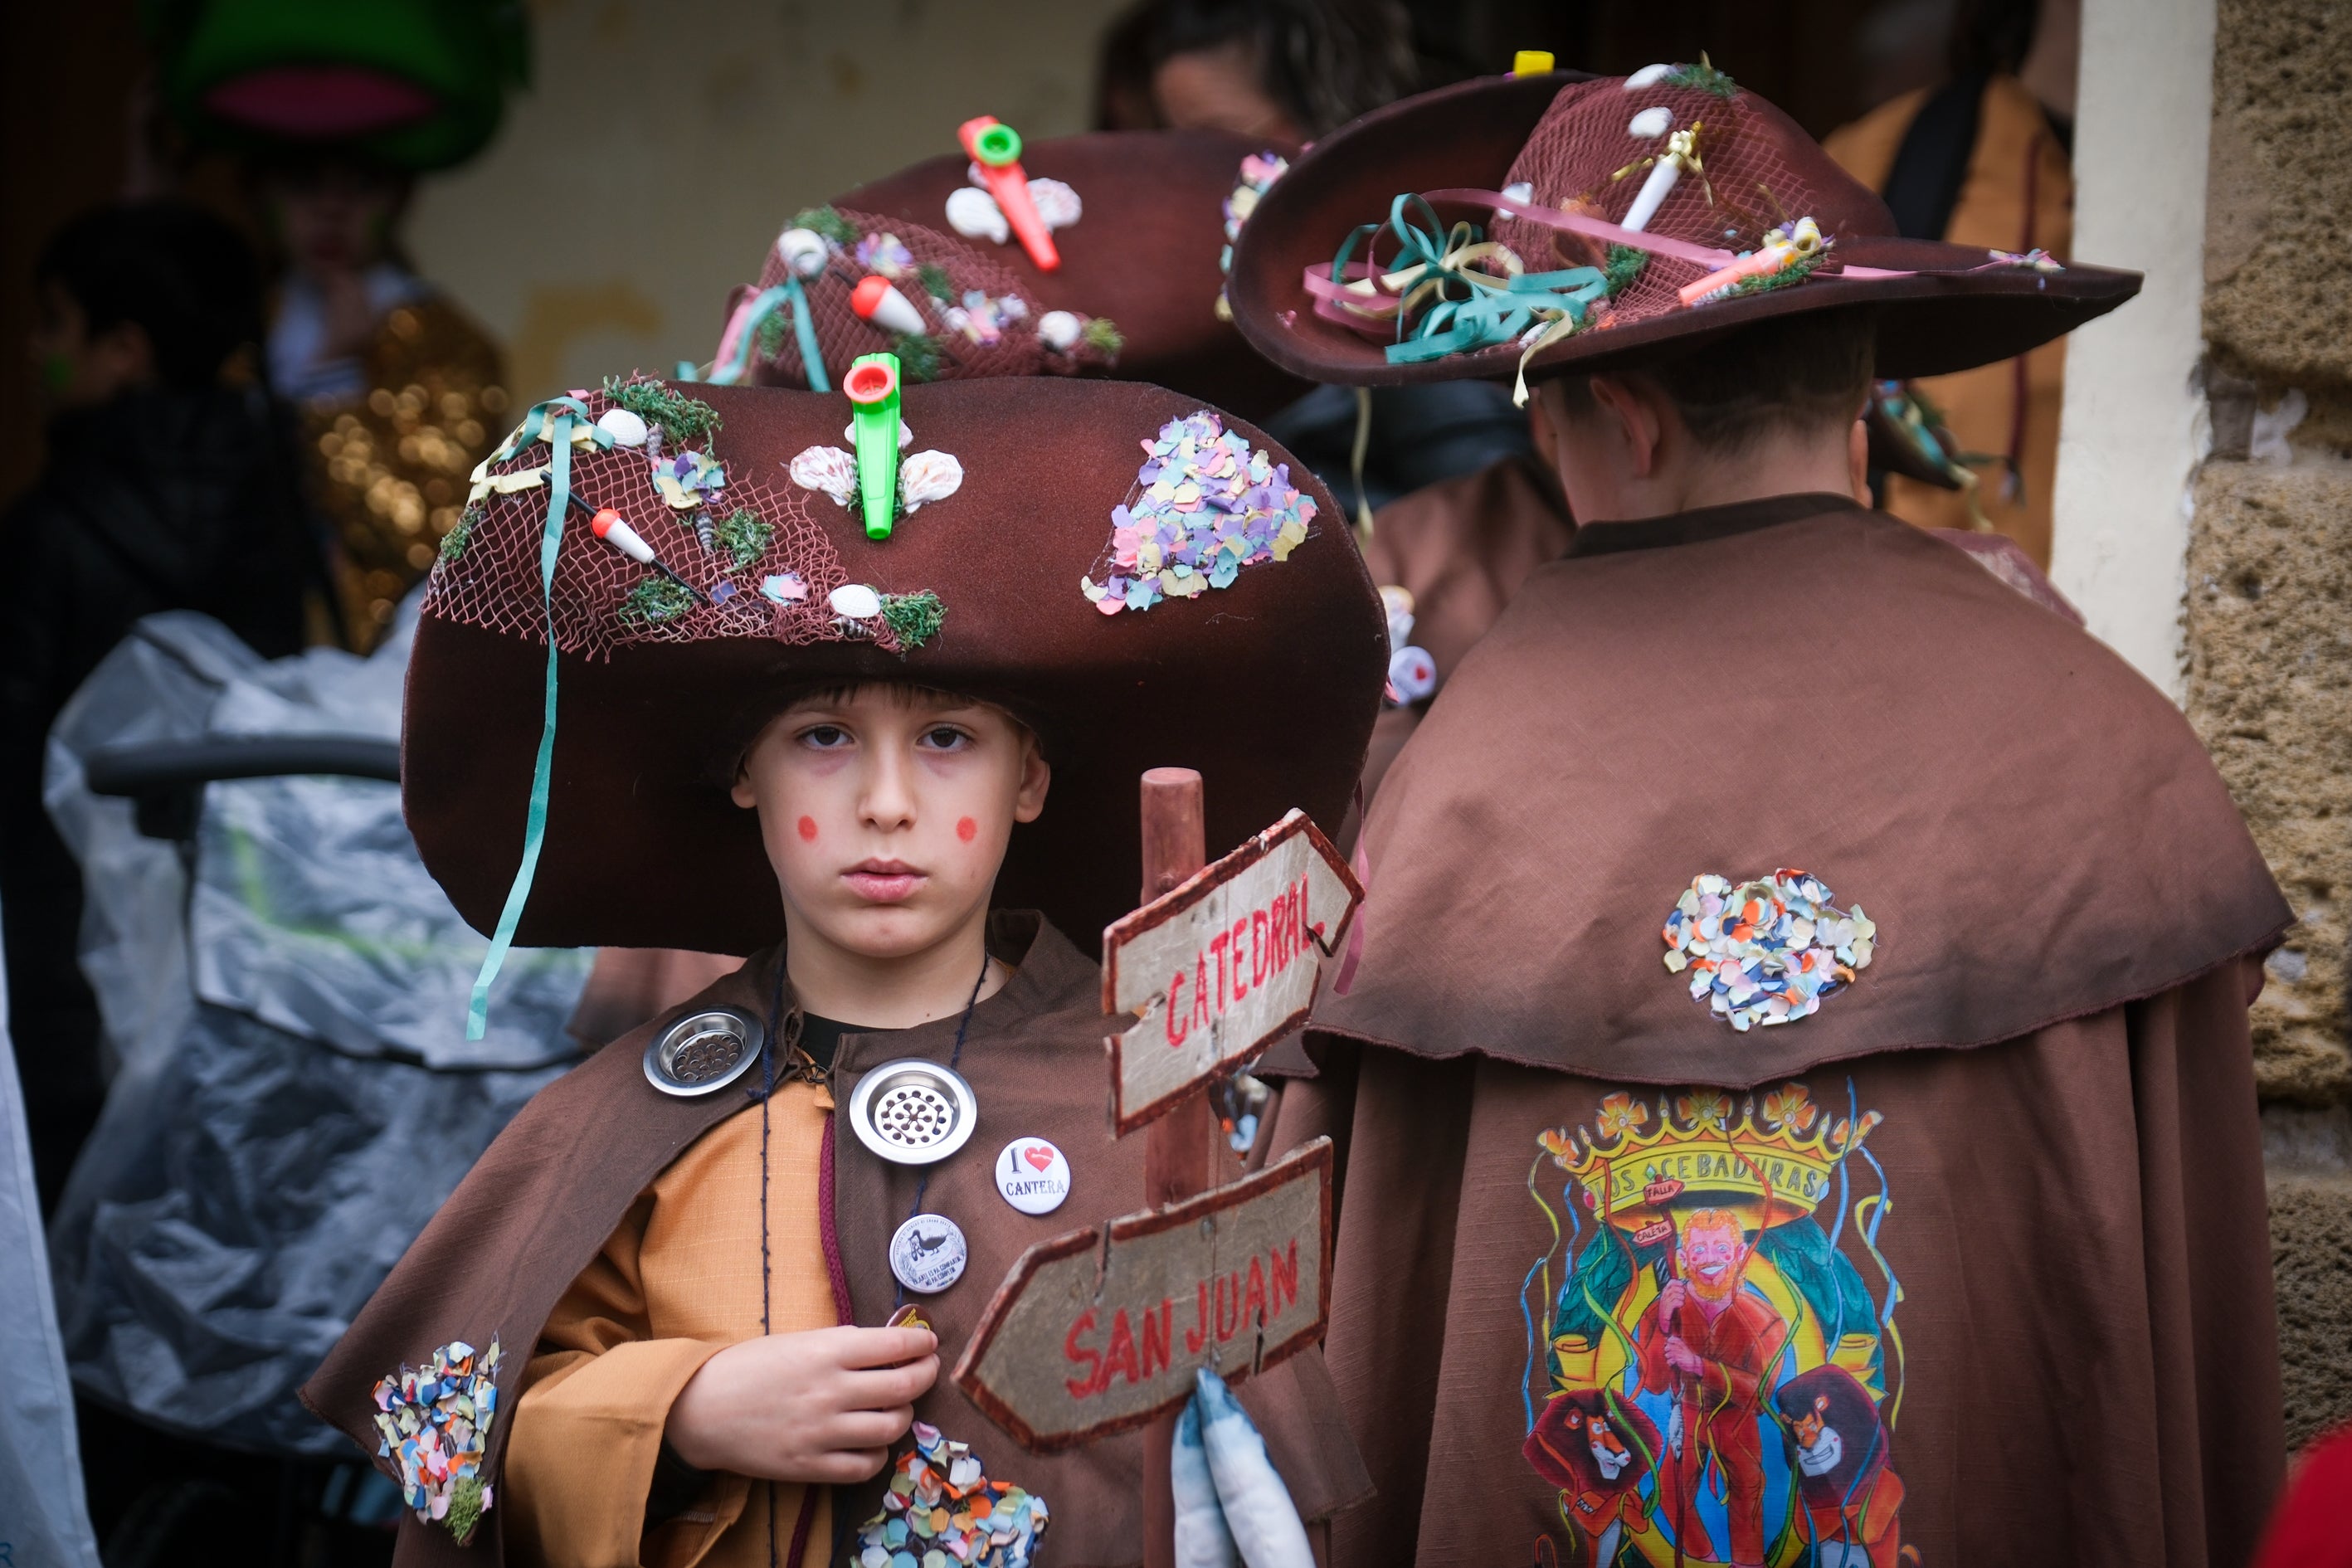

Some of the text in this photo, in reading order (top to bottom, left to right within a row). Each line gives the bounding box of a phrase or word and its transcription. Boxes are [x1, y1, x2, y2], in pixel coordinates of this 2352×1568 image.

[1165, 872, 1325, 1048] CATEDRAL
[1010, 1147, 1022, 1174] I
[1006, 1179, 1066, 1196] CANTERA
[1592, 1153, 1818, 1203] LOS CEBADURAS
[1647, 1185, 1675, 1197] FALLA
[1637, 1225, 1668, 1242] CALETA
[1063, 1237, 1298, 1400] SAN JUAN
